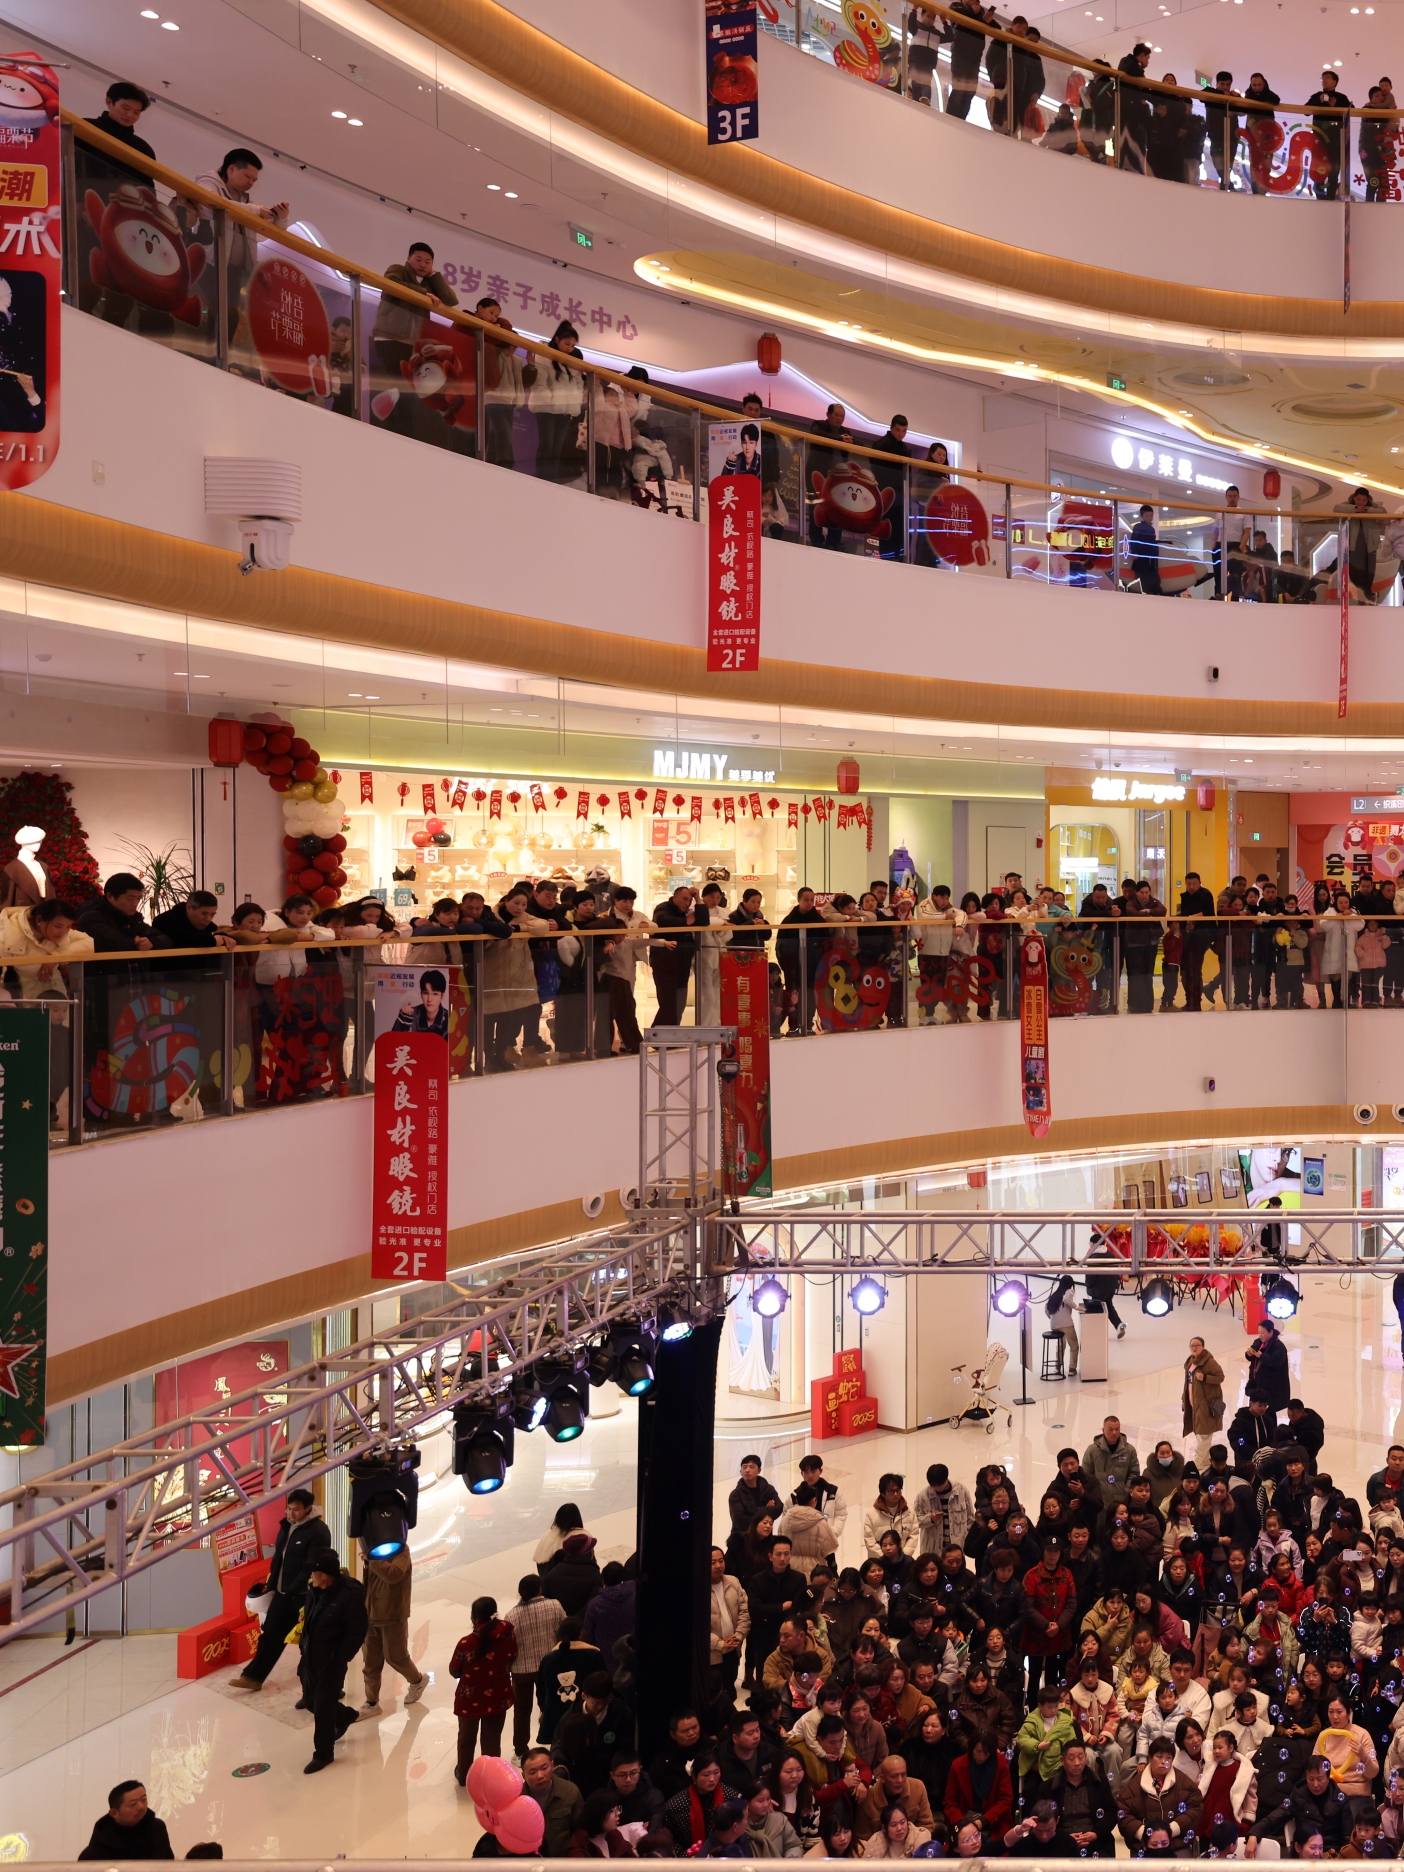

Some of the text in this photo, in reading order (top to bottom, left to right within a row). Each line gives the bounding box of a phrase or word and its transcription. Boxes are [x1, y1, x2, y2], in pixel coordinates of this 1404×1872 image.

[718, 107, 750, 140] 3F
[443, 263, 638, 340] 8岁亲子成长中心
[717, 485, 742, 621] 吴良材眼镜
[721, 649, 746, 668] 2F
[653, 750, 728, 780] MJMY
[1353, 799, 1364, 810] L2
[1326, 854, 1373, 876] 会员
[398, 895, 408, 904] 69
[1025, 988, 1033, 1041] 冰雪女王
[1035, 988, 1043, 1041] 白雪公主
[736, 976, 753, 1088] 有喜事 喝喜力
[1025, 1046, 1045, 1058] 儿童剧
[386, 1045, 421, 1216] 吴良材眼镜
[427, 1078, 438, 1215] 蔡司 依视路 豪雅 授权门店
[379, 1225, 442, 1235] 全套进口验配设备
[379, 1236, 442, 1246] 验光准 更专业
[392, 1251, 427, 1276] 2F
